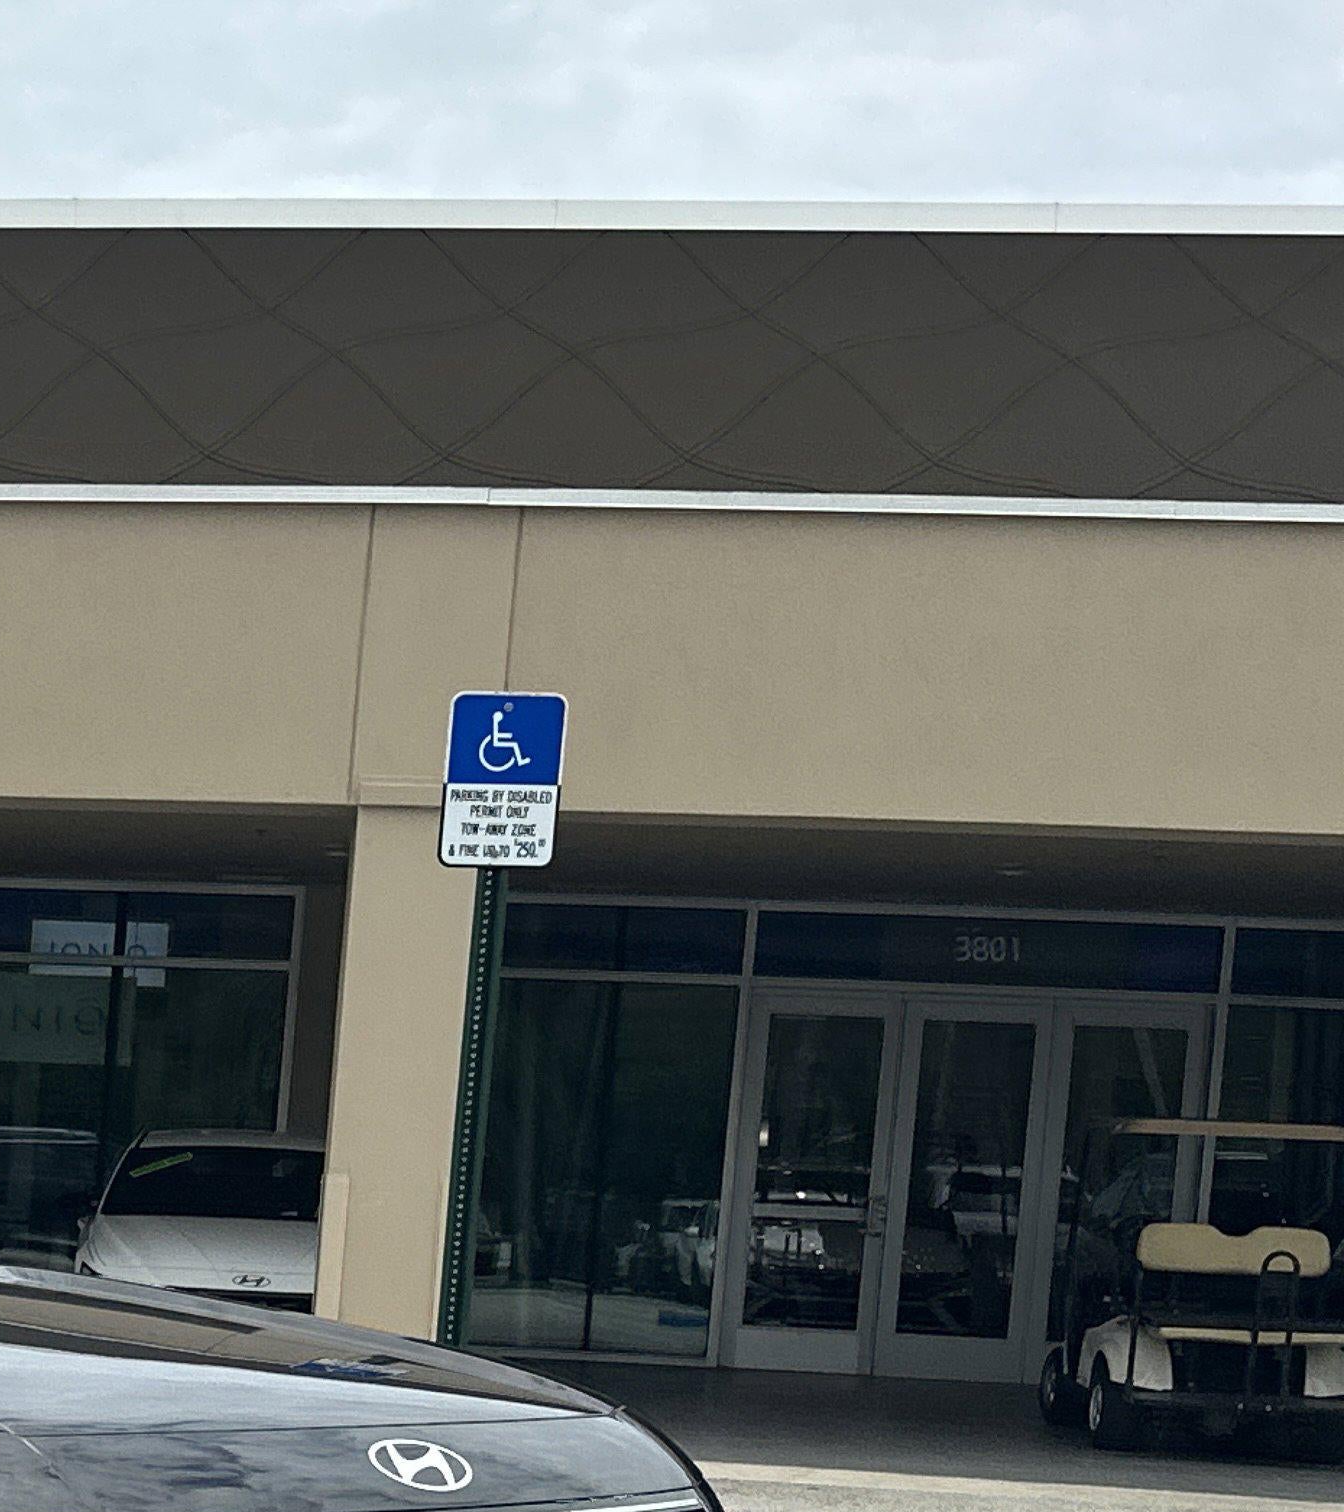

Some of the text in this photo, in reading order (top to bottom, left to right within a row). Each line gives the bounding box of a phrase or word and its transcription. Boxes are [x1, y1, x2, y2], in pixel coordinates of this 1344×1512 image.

[450, 789, 552, 804] PARKING BY DISABLED
[954, 936, 1021, 962] 3801
